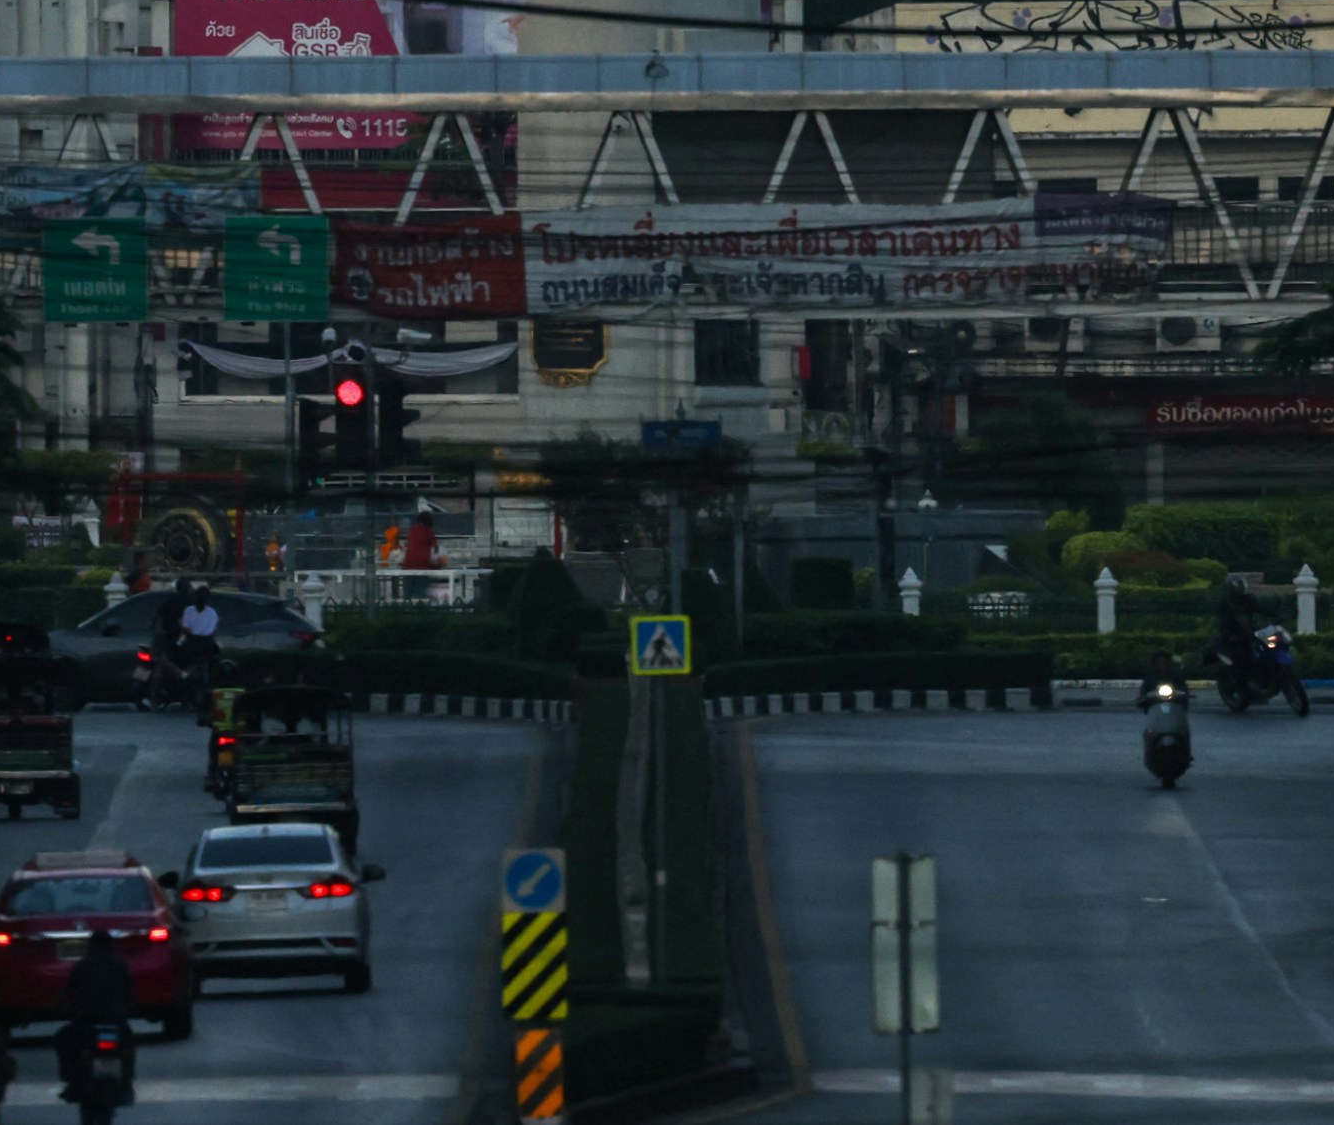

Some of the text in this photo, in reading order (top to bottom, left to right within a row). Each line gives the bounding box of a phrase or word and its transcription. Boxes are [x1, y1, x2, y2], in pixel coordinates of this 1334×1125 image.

[205, 20, 236, 38] ด้วย
[294, 17, 340, 40] สินเชื่อ
[294, 43, 338, 56] GSB
[360, 118, 408, 137] 1115
[376, 271, 491, 308] รถไฟฟ้า
